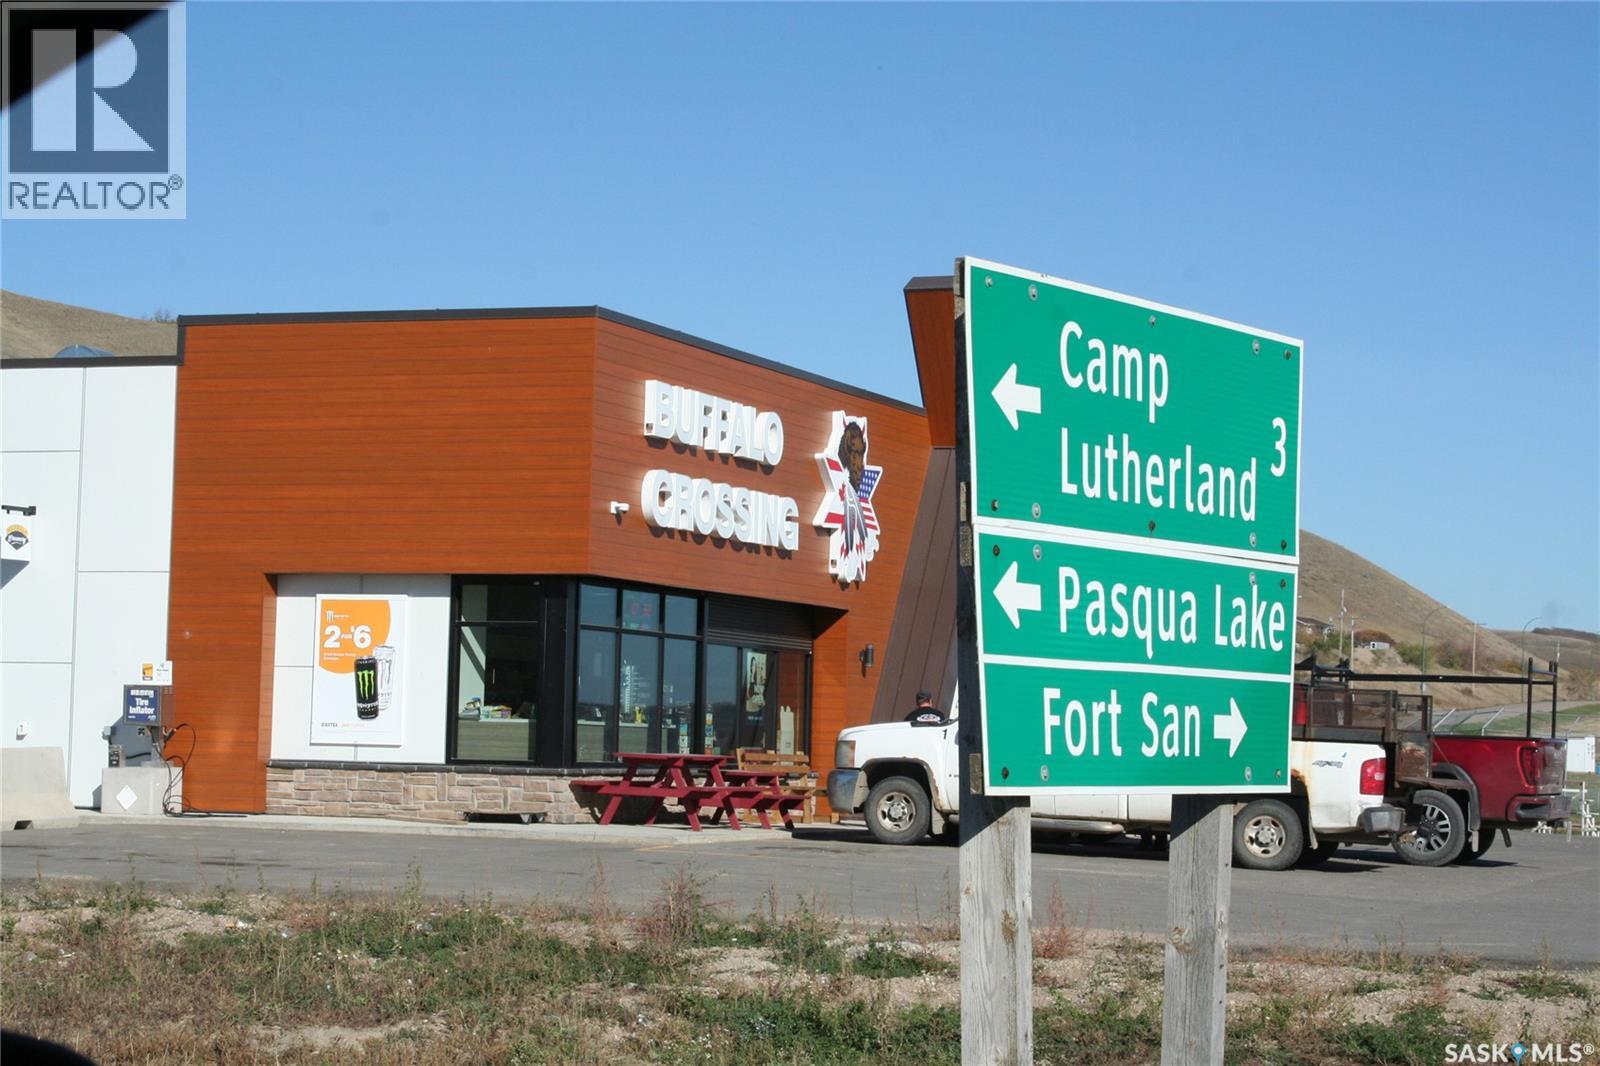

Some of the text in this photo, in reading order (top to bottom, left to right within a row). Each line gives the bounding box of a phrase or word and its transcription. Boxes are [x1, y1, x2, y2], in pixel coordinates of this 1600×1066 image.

[1059, 320, 1169, 424] Camp
[643, 379, 784, 467] BUFFALO
[641, 469, 799, 551] CROSSING
[1060, 416, 1287, 522] Lutherland 3
[323, 625, 341, 649] 2
[1058, 566, 1286, 659] Pasqua Lake
[129, 706, 155, 715] Inflator
[135, 697, 149, 706] Tire
[1043, 687, 1201, 758] Fort San
